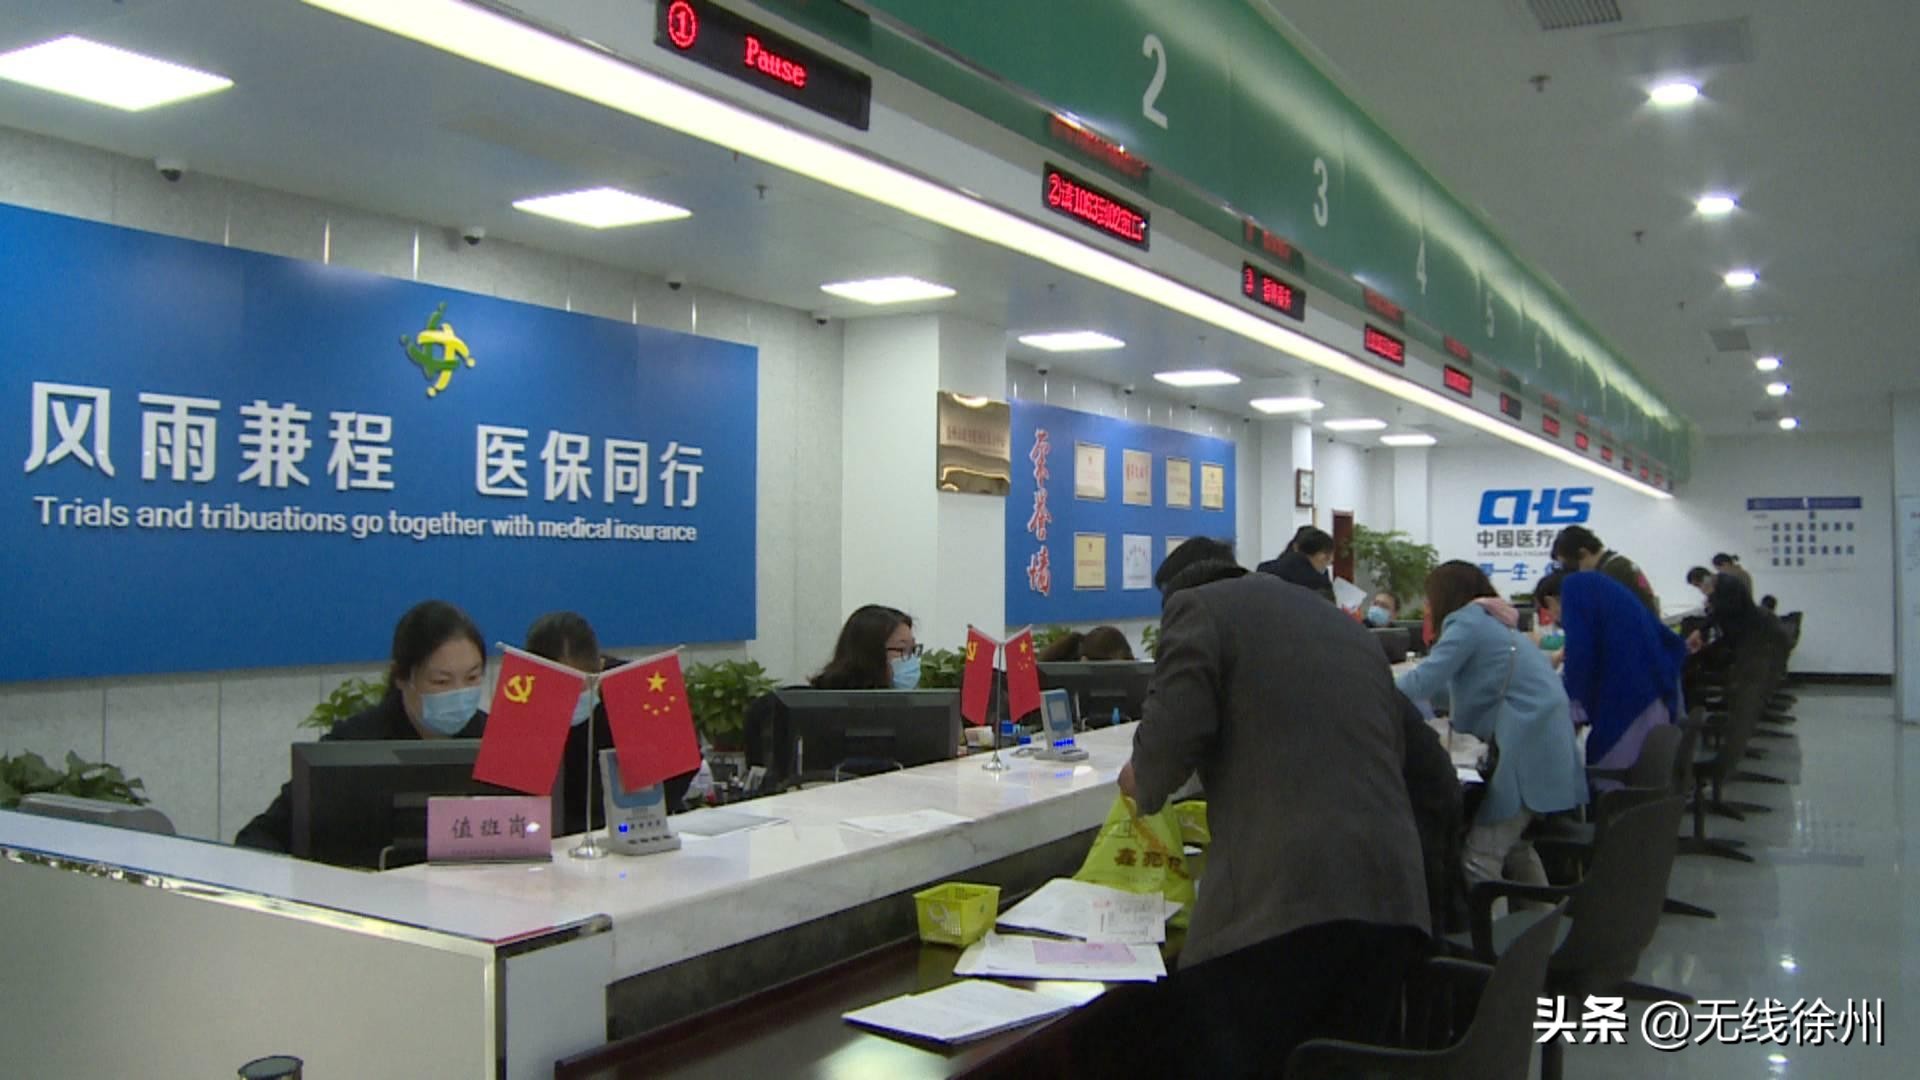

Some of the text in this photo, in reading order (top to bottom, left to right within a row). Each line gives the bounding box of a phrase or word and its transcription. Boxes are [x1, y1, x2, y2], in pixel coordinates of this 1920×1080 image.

[744, 36, 807, 87] Pause
[1142, 34, 1168, 127] 2
[1313, 157, 1328, 227] 3
[1416, 239, 1427, 296] 4
[24, 381, 704, 507] 风雨兼程 医保同行
[34, 495, 697, 542] Trials and tribuations go together with medical insurance
[1477, 487, 1594, 526] CHS
[1477, 529, 1562, 548] 中国医疗
[452, 813, 526, 839] 值班岗
